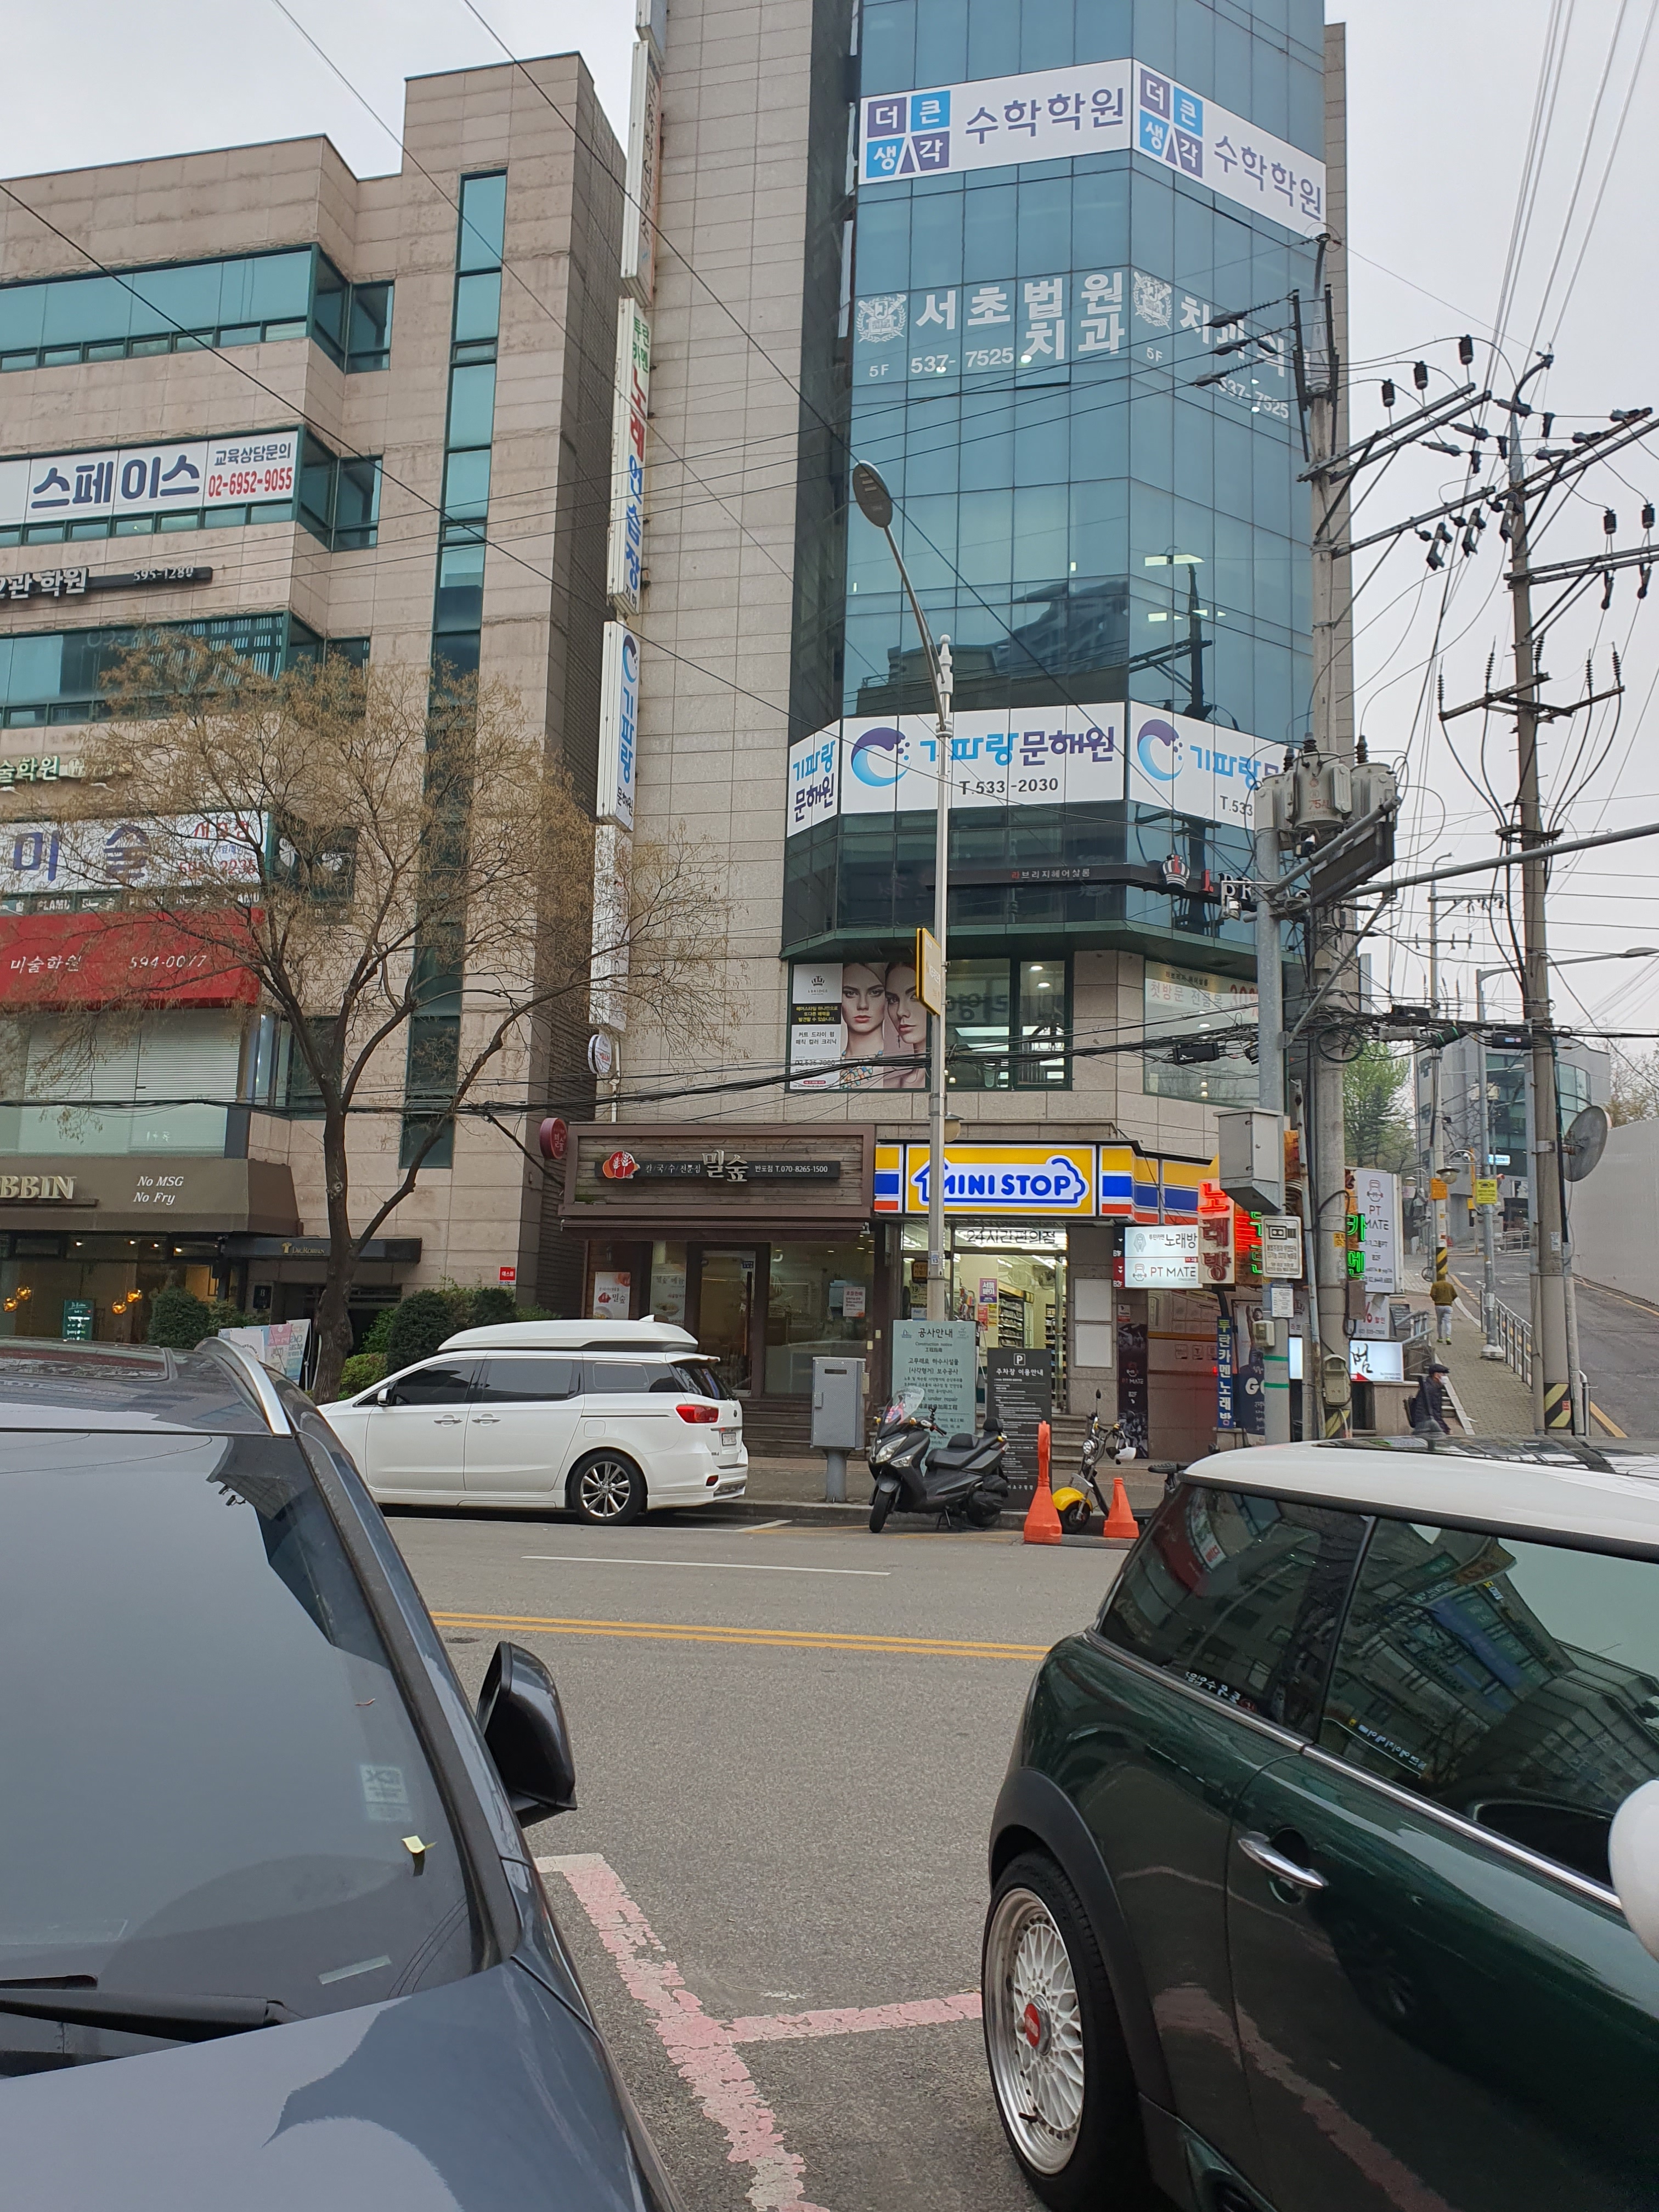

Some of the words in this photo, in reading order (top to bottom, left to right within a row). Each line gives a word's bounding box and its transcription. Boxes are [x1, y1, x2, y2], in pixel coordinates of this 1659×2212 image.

[873, 99, 941, 127] 더큰
[1146, 77, 1198, 122] 더큰
[966, 87, 1125, 144] 수학학원
[873, 137, 943, 171] 생각
[1146, 121, 1199, 168] 생각
[1214, 134, 1321, 222] 수학학원
[916, 272, 1122, 330] 서초법원
[1023, 313, 1125, 361] 치과
[1147, 347, 1163, 362] 5F
[869, 364, 890, 378] 5F
[214, 442, 291, 466] 교육상담문의
[31, 454, 200, 510] 스페이스
[208, 466, 293, 498] 02-6952-9055
[40, 567, 88, 597] 학원
[133, 566, 194, 582] 595-1280
[792, 740, 837, 781] 기파랑
[794, 776, 834, 823] 문해원
[10, 955, 82, 974] 미술학원
[702, 1149, 749, 1182] 밀숲
[755, 1165, 773, 1173] 반포점
[137, 1176, 153, 1187] No
[156, 1176, 184, 1187] MSG
[1001, 1175, 1070, 1196] STOP
[133, 1192, 150, 1203] No
[153, 1192, 175, 1206] Fry
[1369, 1205, 1382, 1216] PT
[1165, 1233, 1198, 1249] 노래방
[1150, 1267, 1163, 1277] PT
[1166, 1267, 1196, 1277] MATE
[918, 1328, 953, 1338] 공사안내
[996, 1368, 1015, 1376] 주차장
[1016, 1355, 1023, 1364] P
